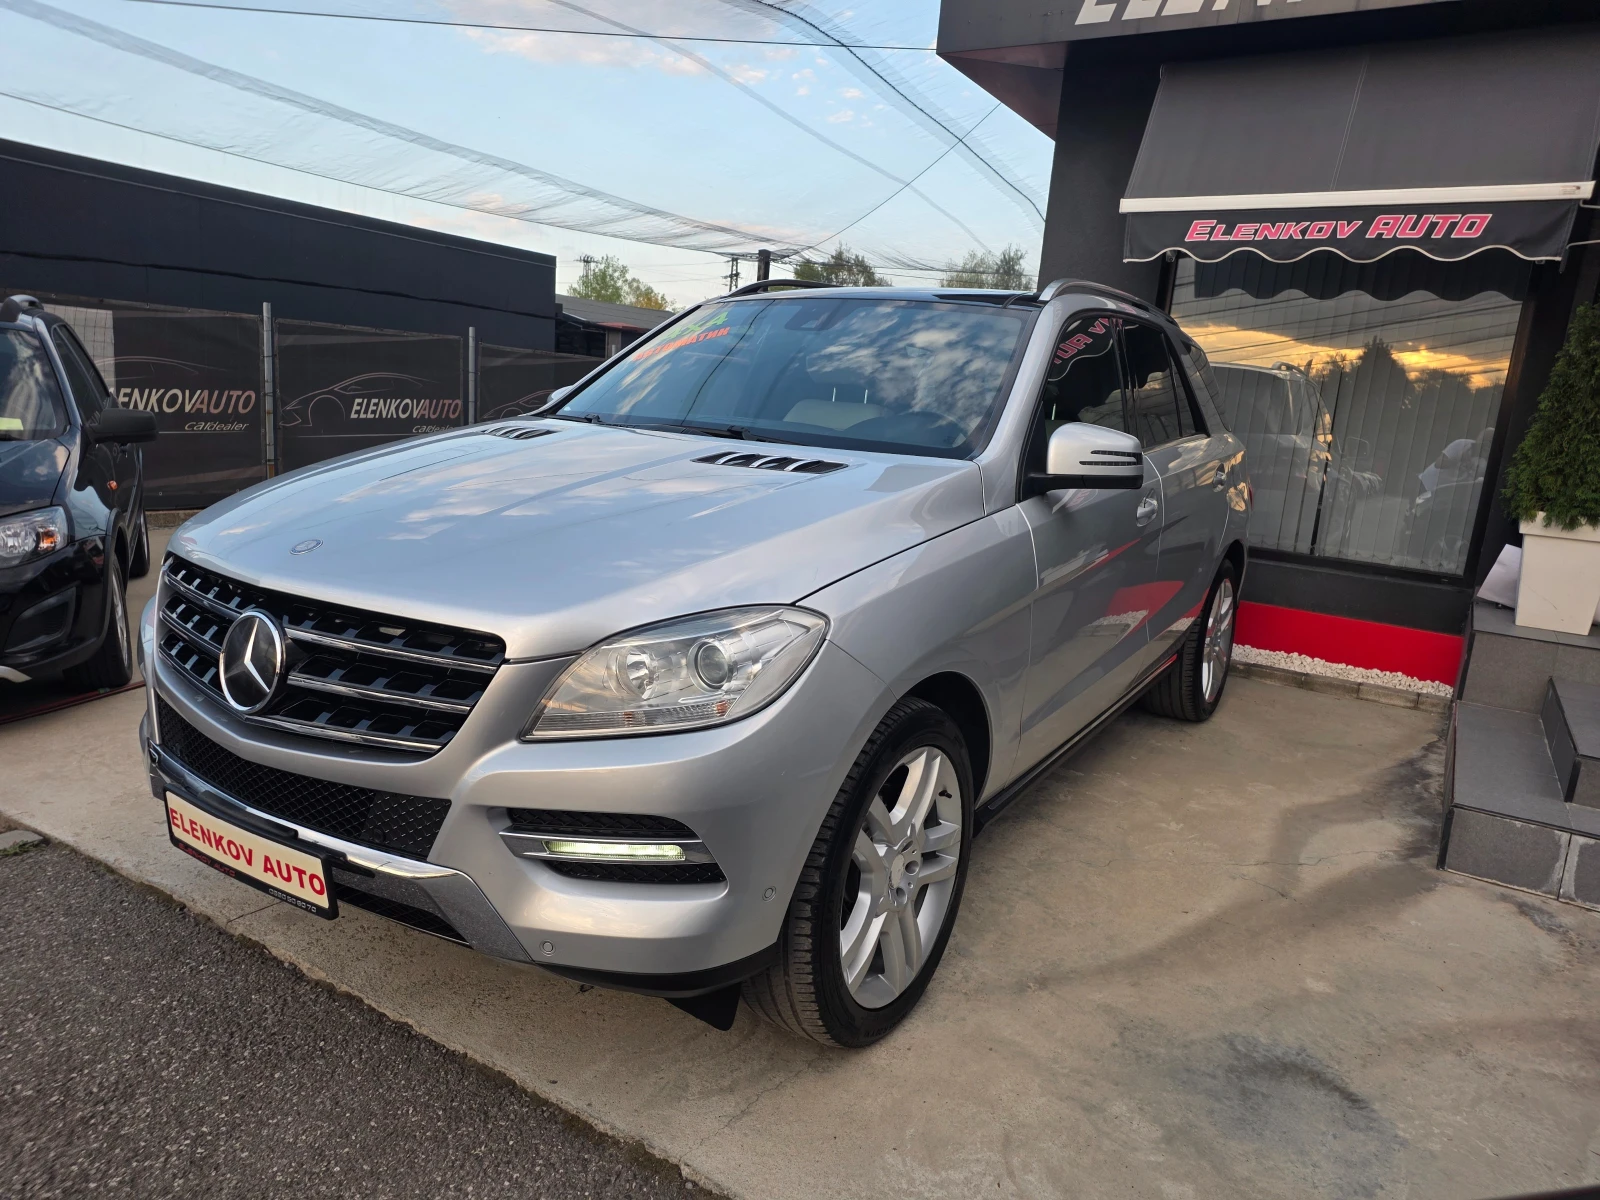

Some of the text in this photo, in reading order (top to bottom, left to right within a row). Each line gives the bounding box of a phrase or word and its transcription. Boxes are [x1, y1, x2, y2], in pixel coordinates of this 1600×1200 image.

[1185, 213, 1493, 242] ELENKOV AUTO
[169, 807, 326, 896] ELENKOV AUTO
